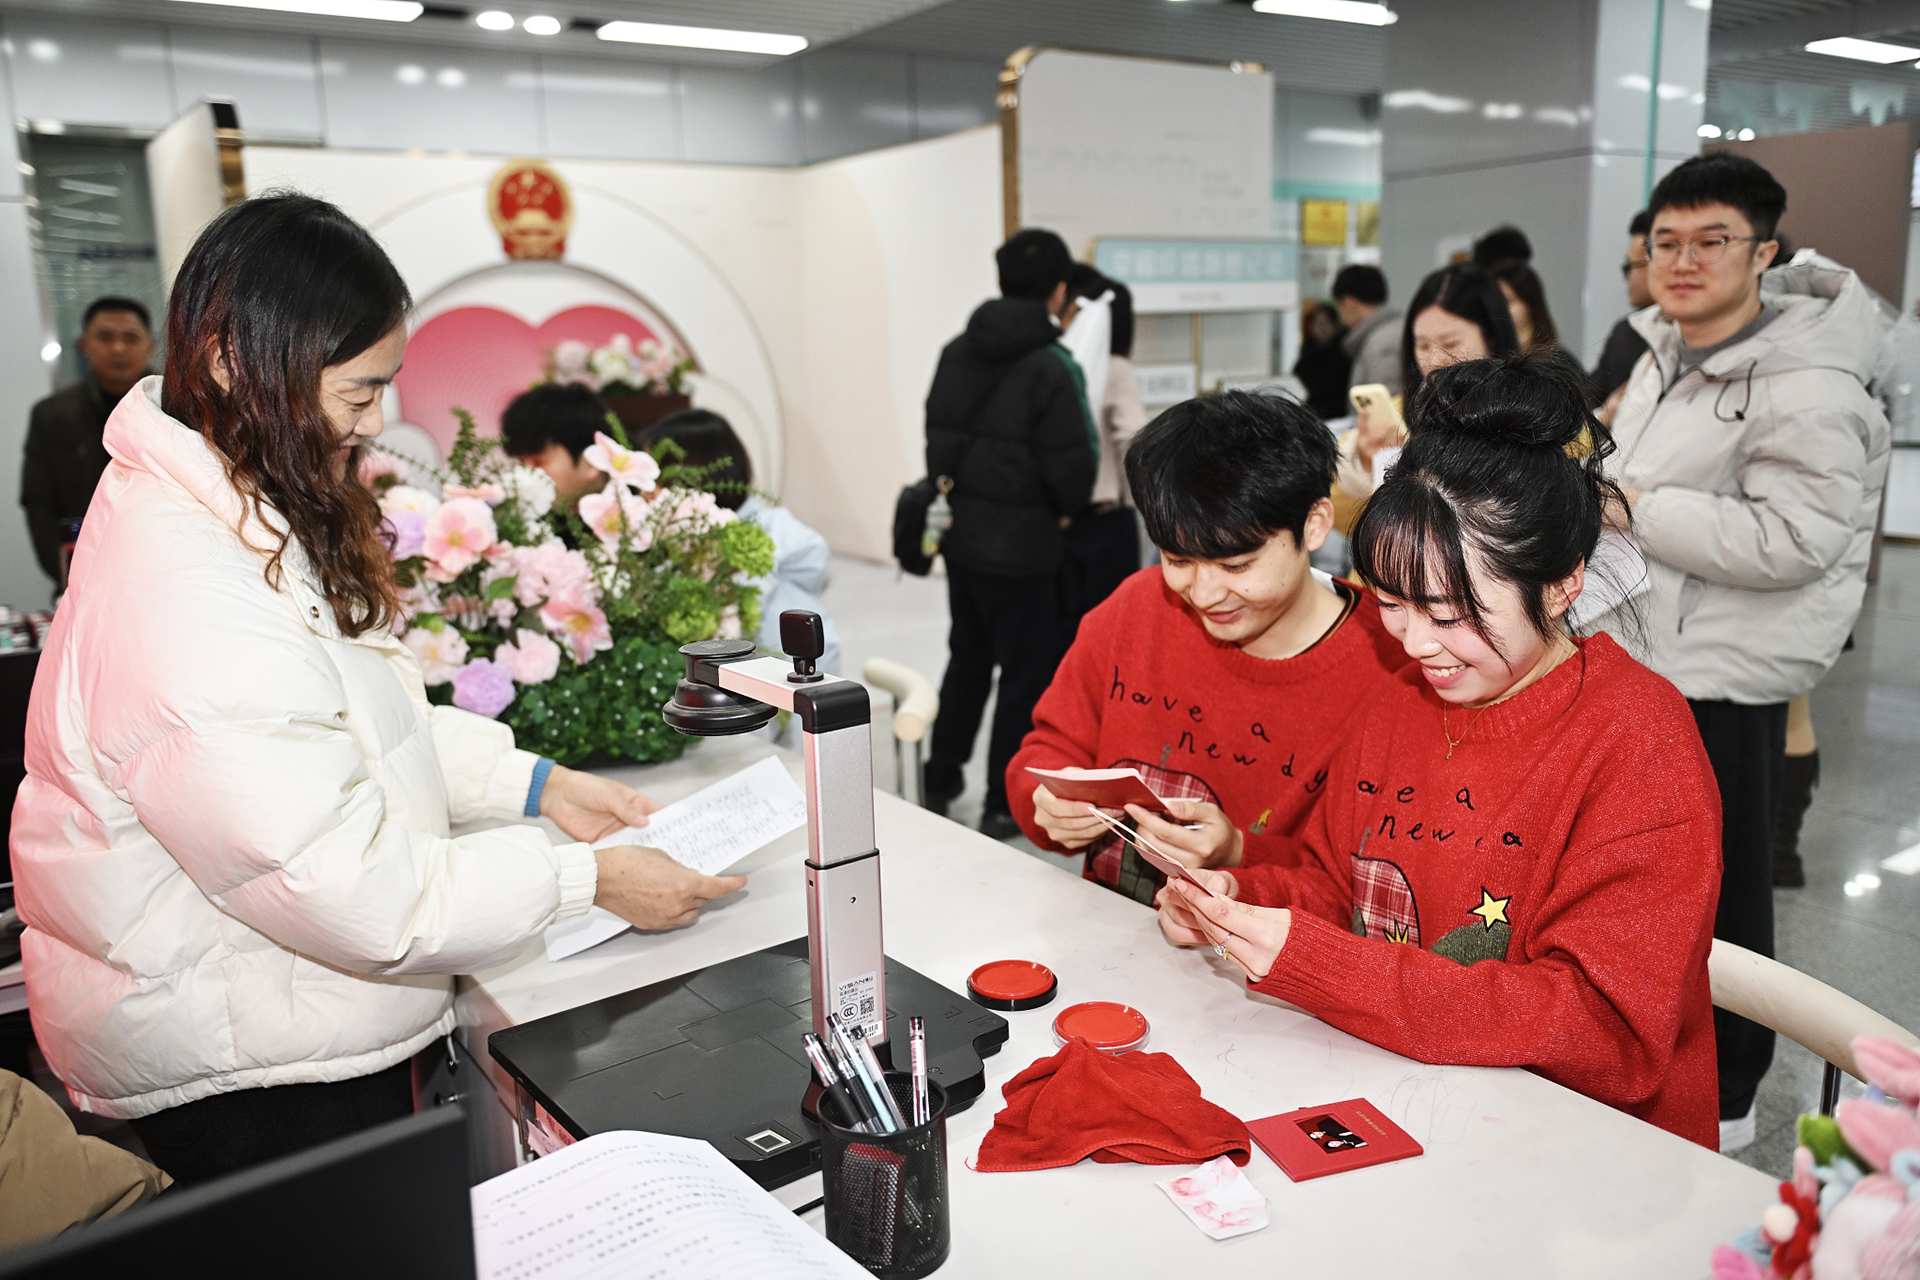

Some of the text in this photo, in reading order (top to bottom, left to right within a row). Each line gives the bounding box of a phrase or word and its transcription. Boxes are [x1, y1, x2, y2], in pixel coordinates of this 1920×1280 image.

[1110, 665, 1271, 743] have a
[1178, 731, 1257, 766] new
[1455, 787, 1475, 810] a
[1378, 814, 1455, 841] new
